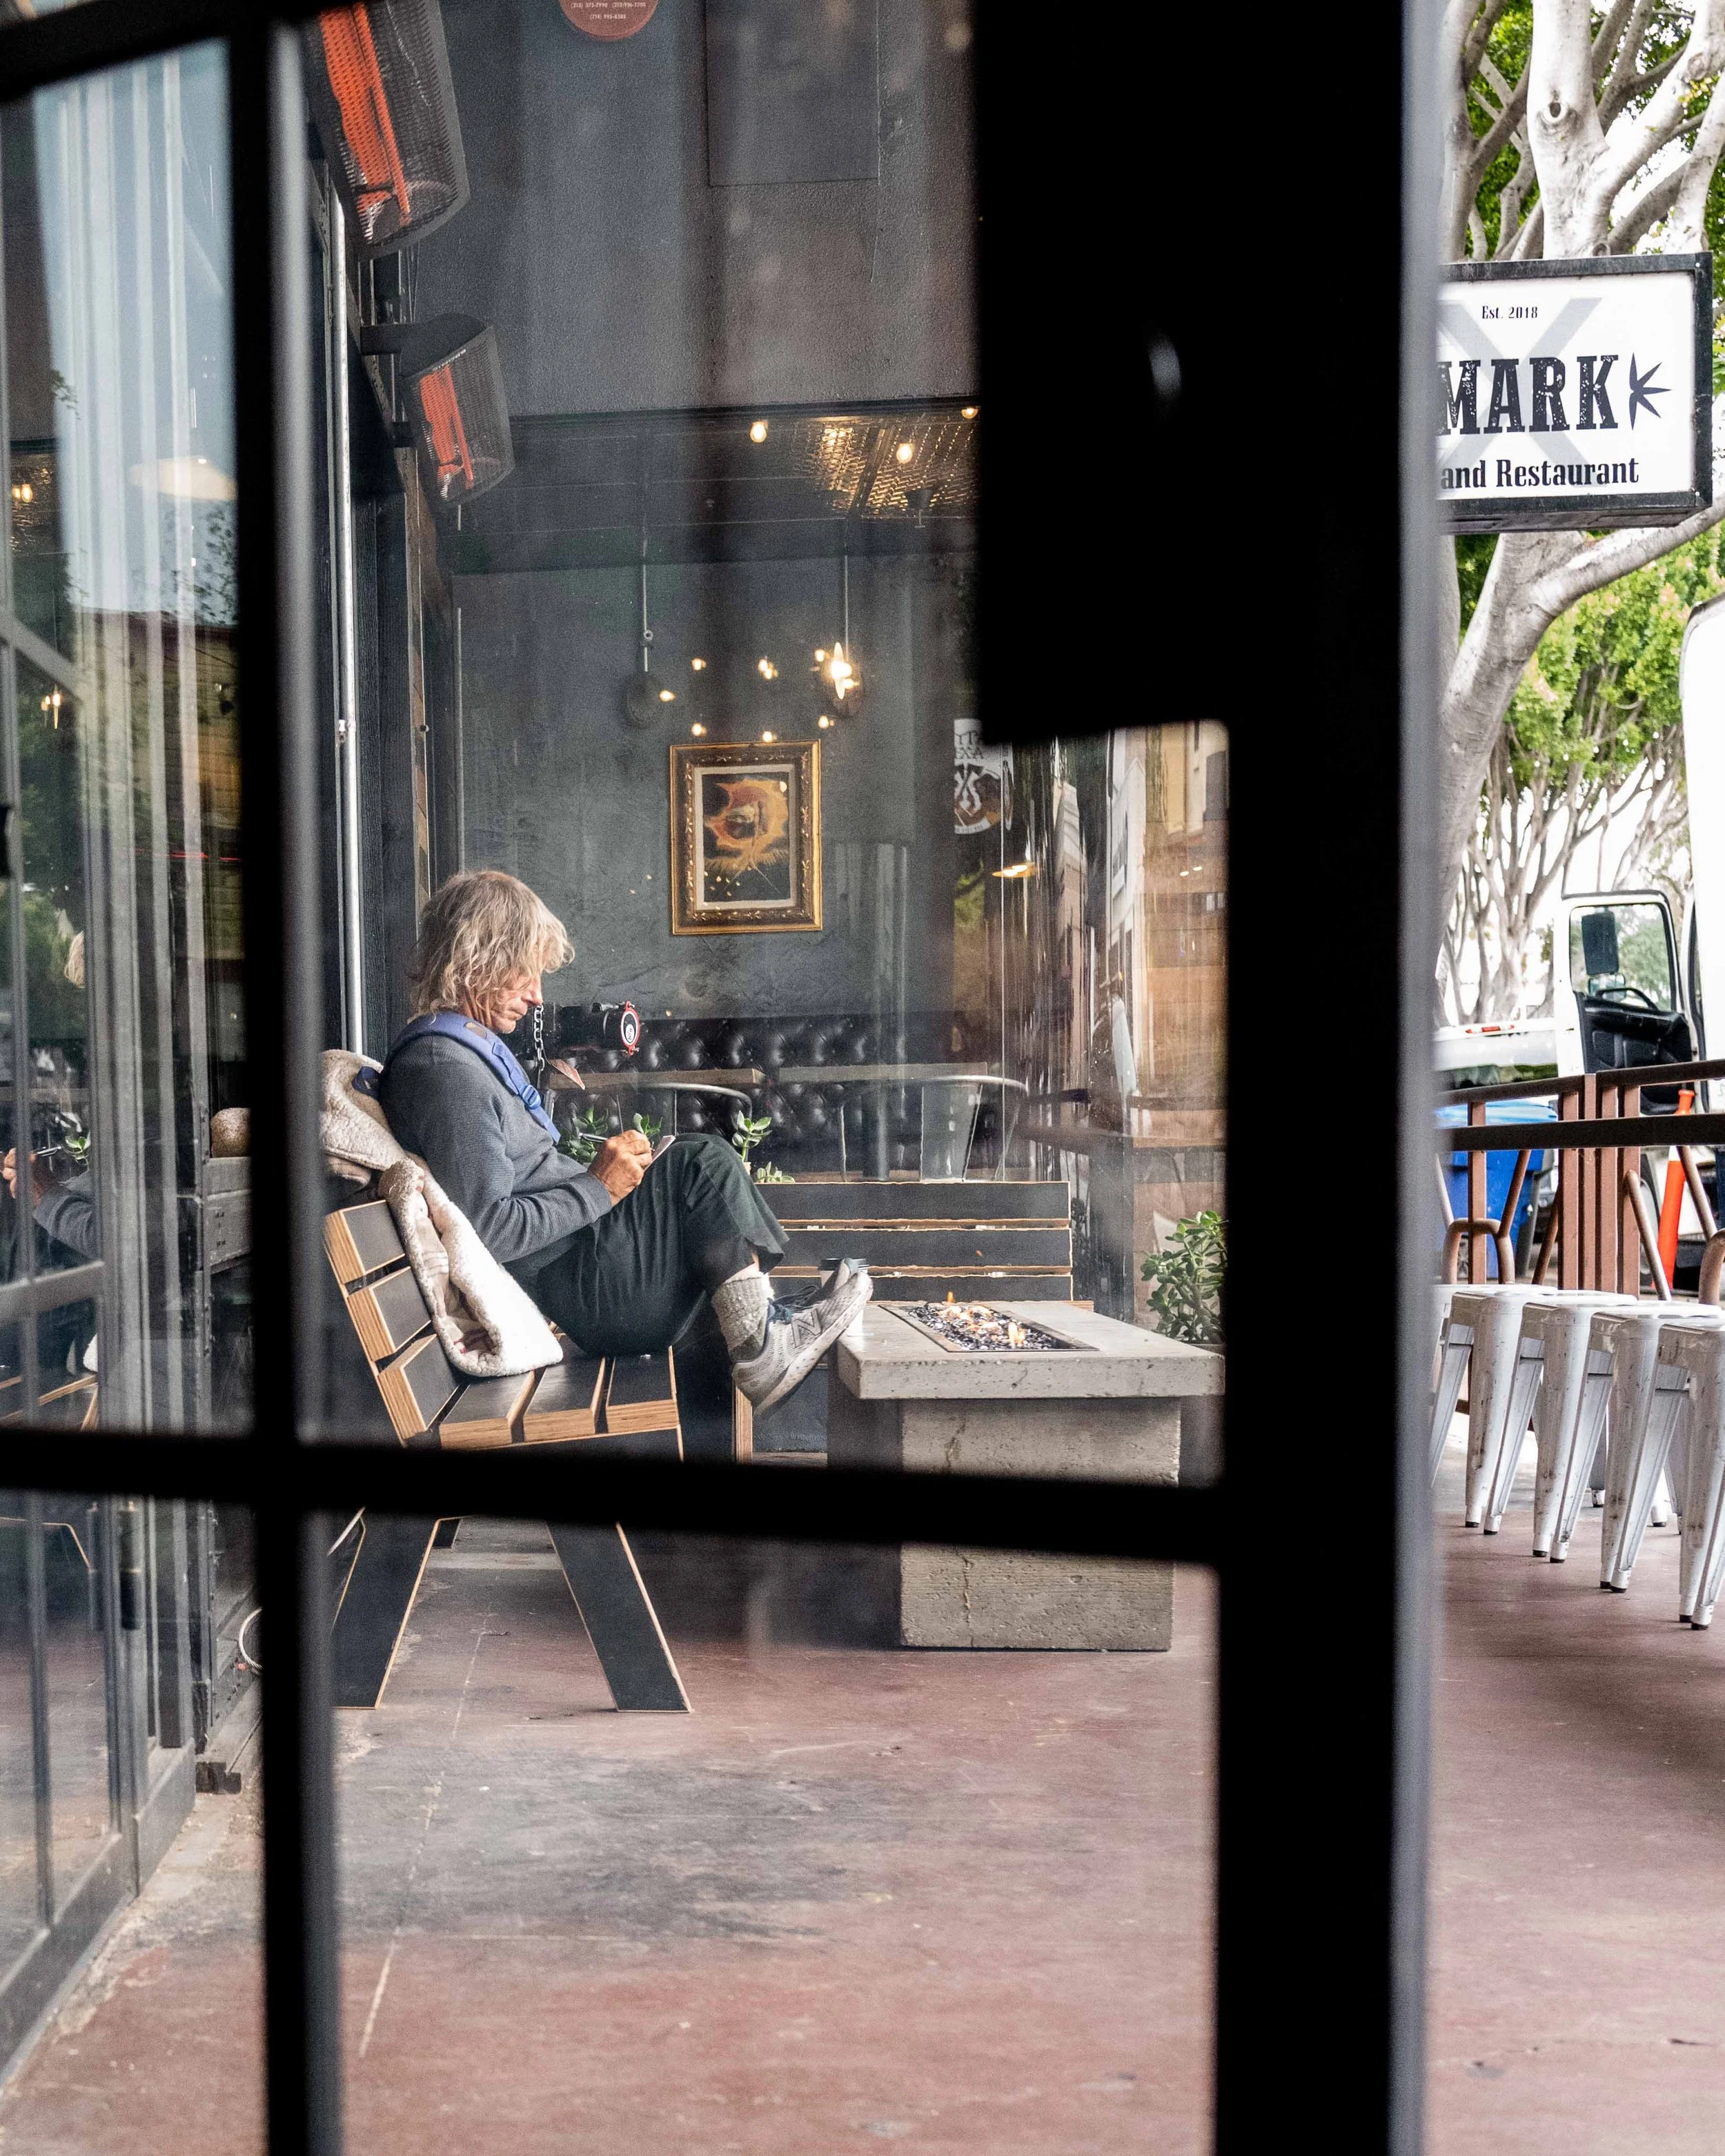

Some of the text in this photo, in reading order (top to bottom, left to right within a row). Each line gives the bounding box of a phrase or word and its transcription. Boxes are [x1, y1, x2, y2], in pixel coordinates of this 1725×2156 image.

[1481, 306, 1538, 319] Est. 2018
[1437, 354, 1619, 435] MARK
[1441, 458, 1639, 488] and Restaurant
